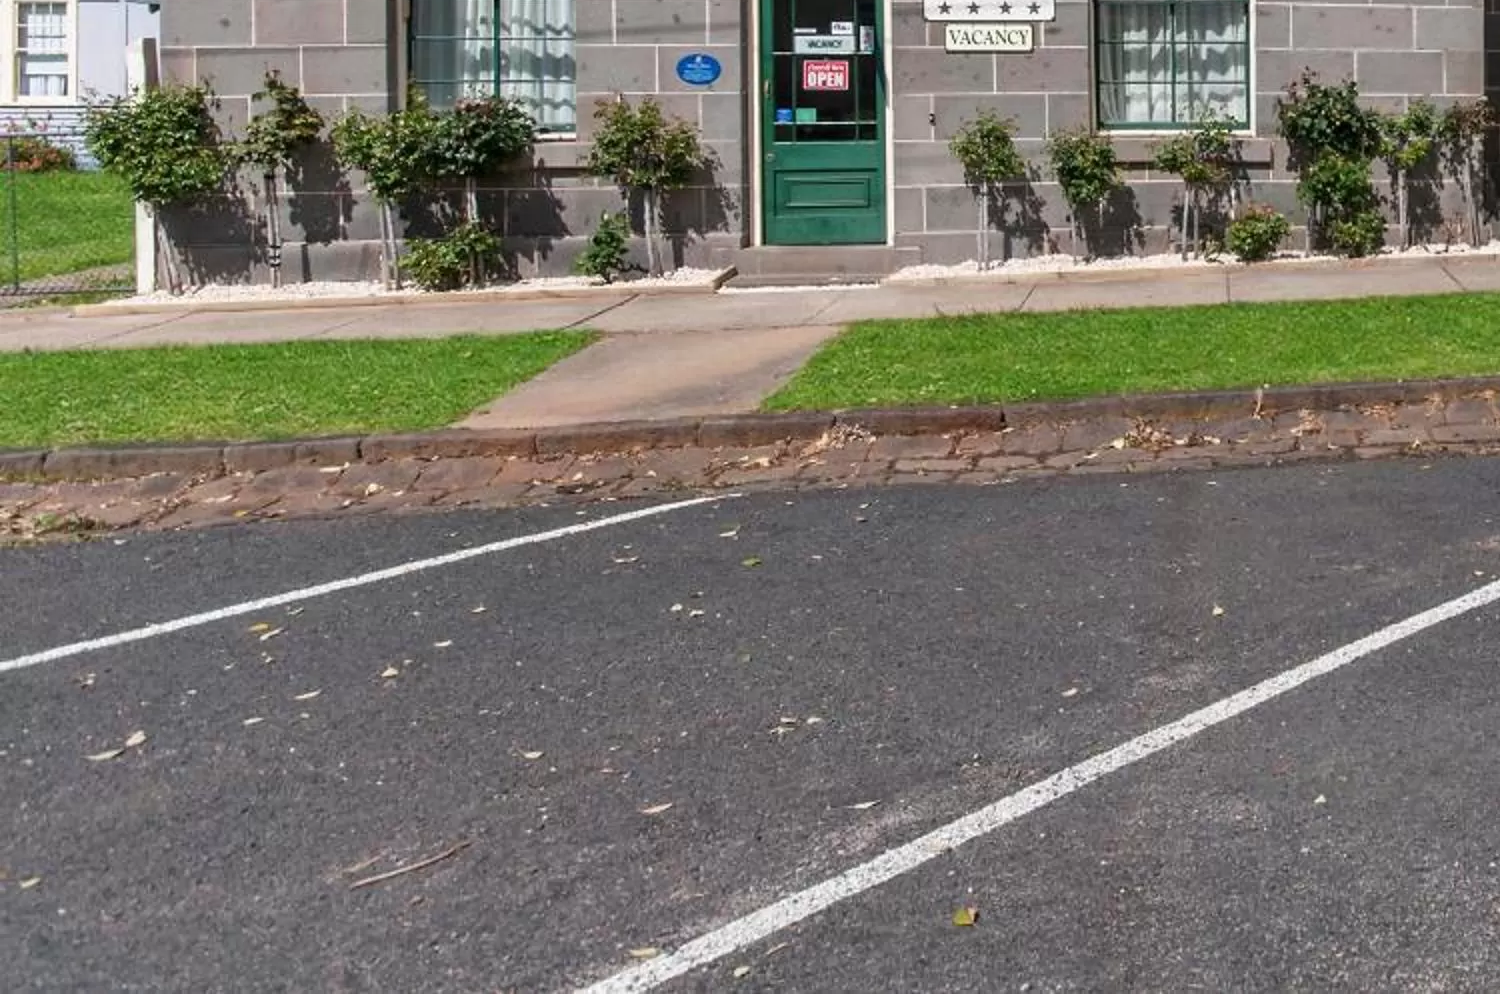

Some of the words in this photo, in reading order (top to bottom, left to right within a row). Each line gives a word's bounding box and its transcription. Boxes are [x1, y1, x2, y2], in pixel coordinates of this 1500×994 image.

[807, 39, 843, 49] VACANCY
[949, 29, 1029, 46] VACANCY
[807, 71, 844, 87] OPEN
